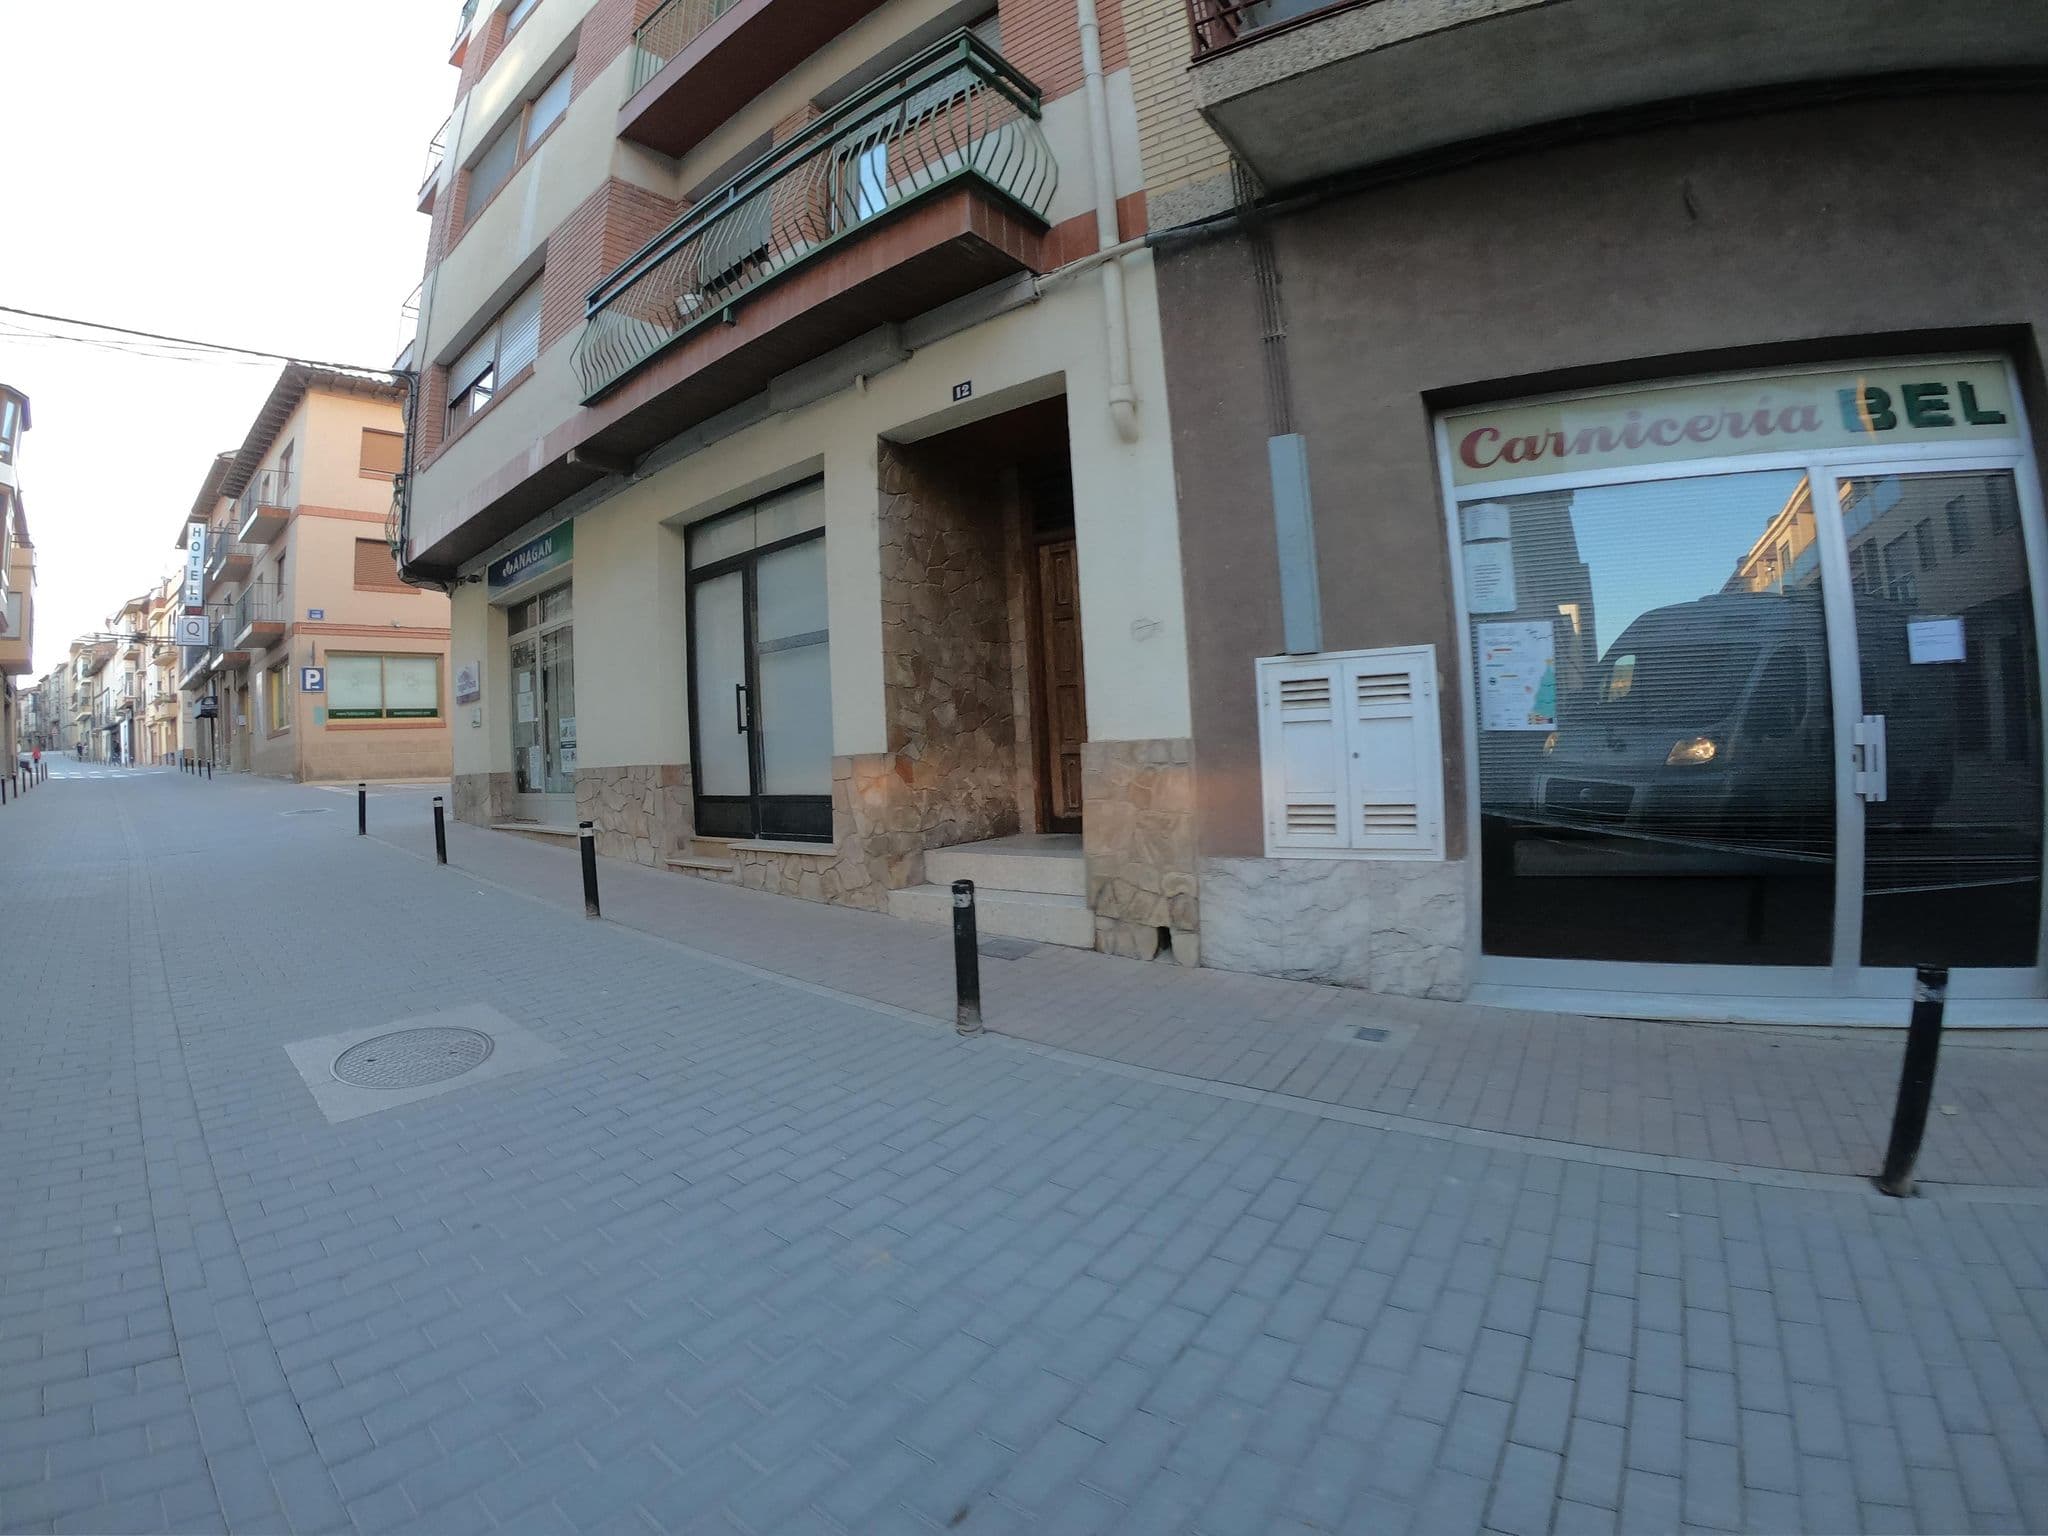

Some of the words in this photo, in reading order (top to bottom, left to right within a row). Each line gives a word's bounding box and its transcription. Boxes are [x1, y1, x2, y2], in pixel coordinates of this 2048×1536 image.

[956, 384, 970, 399] 12
[1836, 380, 2007, 433] BEL
[189, 527, 201, 596] HOTEL
[513, 537, 552, 573] ANAGAN
[186, 621, 200, 637] Q
[305, 669, 321, 690] P
